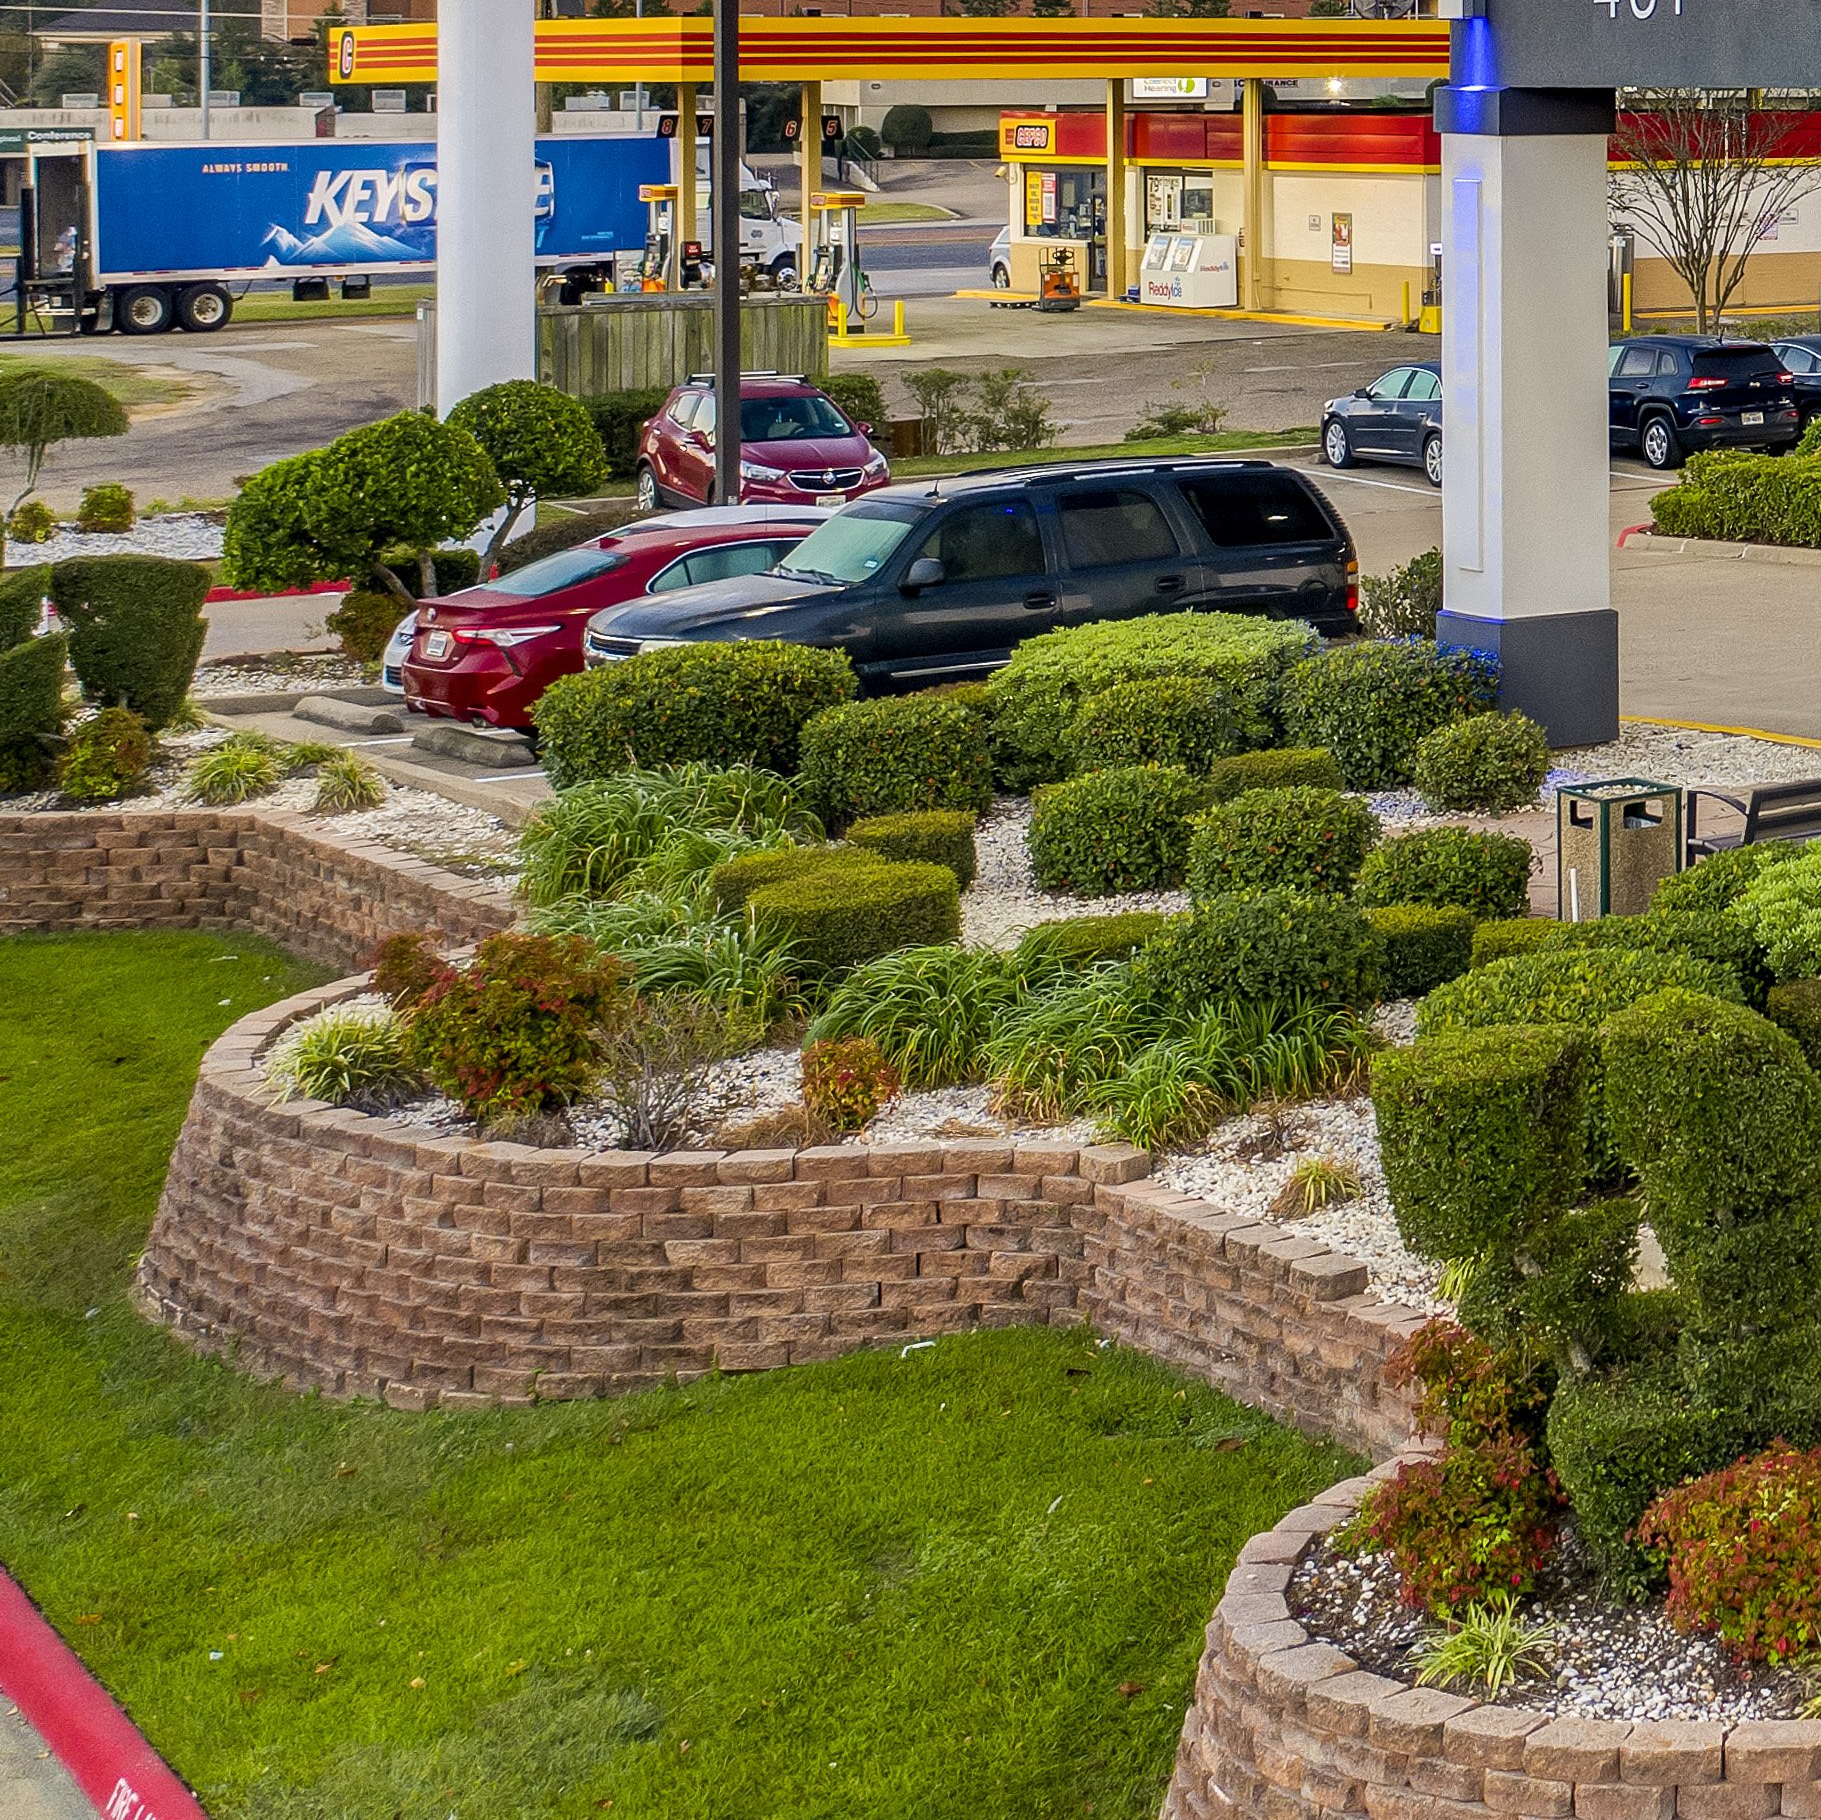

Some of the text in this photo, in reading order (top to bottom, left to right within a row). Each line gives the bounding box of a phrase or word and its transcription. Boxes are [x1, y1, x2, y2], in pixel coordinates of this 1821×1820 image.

[661, 118, 674, 134] 8
[701, 118, 713, 134] 7
[785, 120, 798, 138] 6
[825, 119, 839, 137] 5
[27, 131, 92, 140] Conference
[202, 163, 243, 174] ALWAYS
